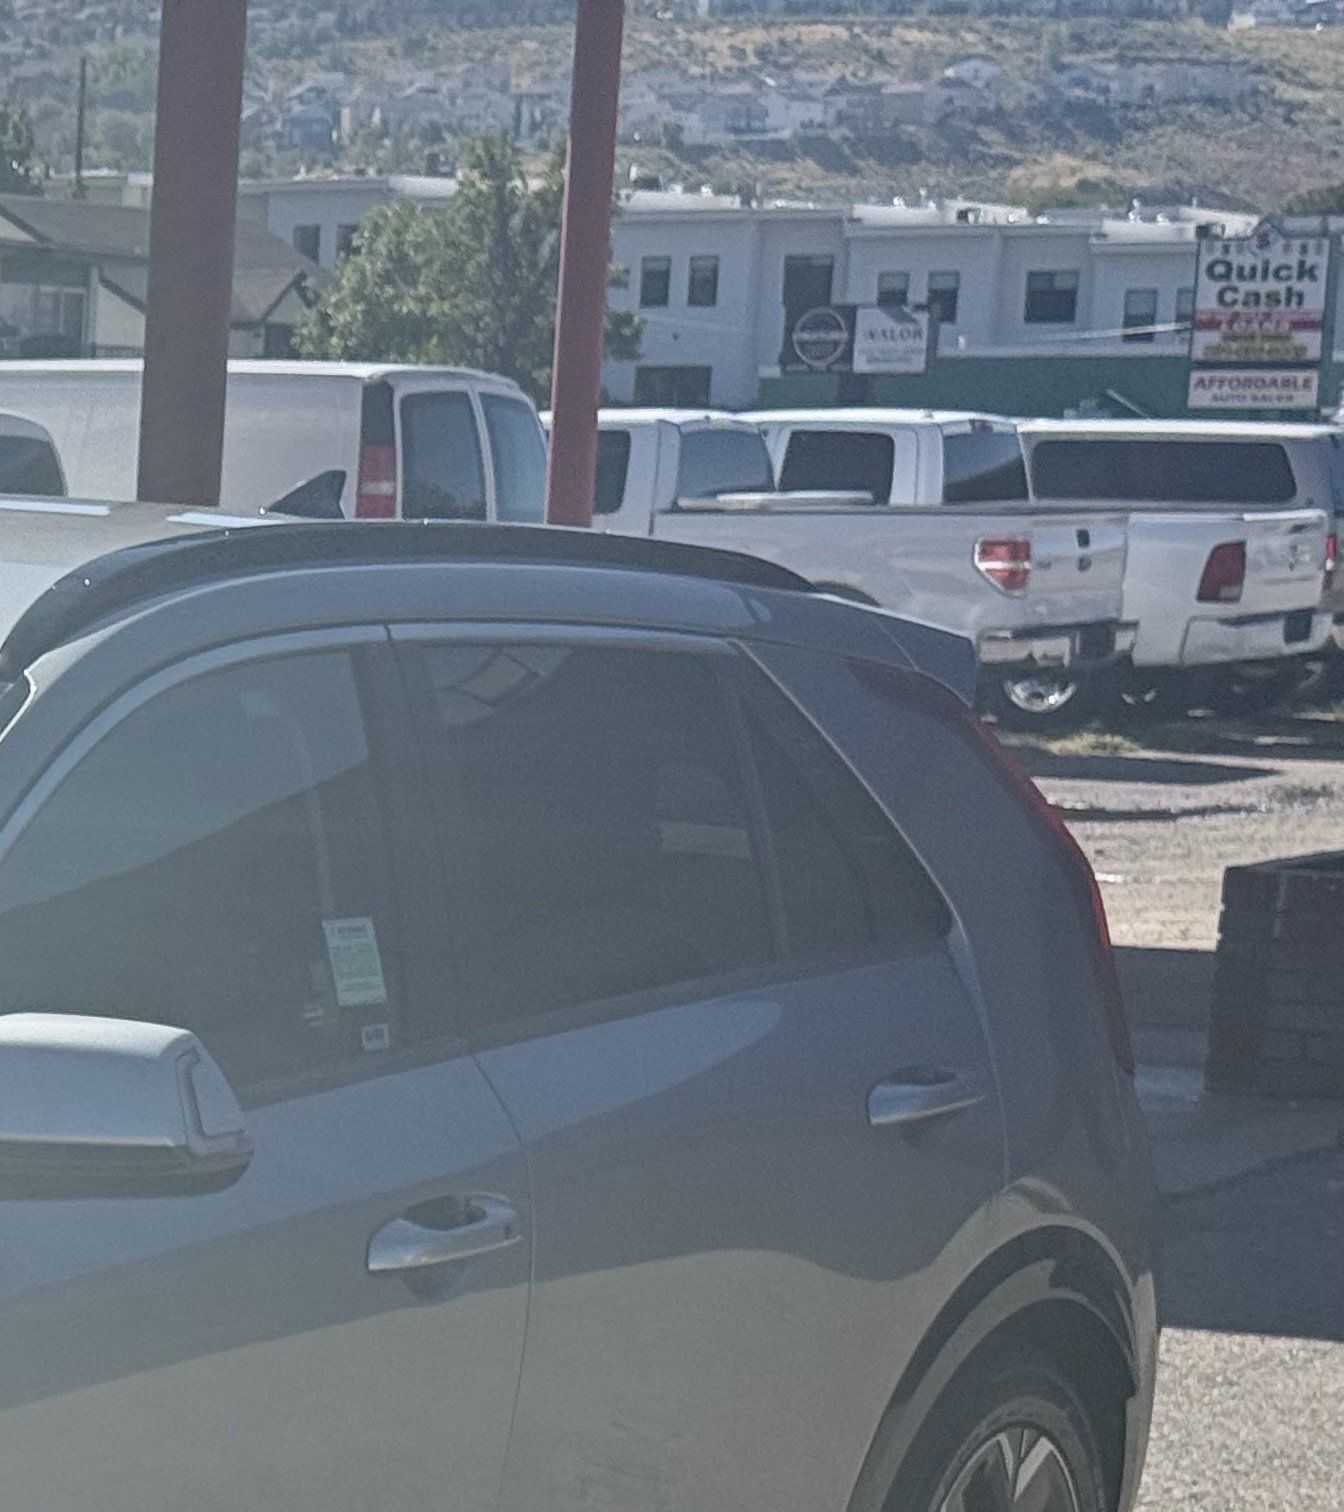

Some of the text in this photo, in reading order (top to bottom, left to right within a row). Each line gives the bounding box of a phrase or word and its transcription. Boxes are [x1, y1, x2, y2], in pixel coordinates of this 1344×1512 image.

[1205, 258, 1319, 282] Quick
[1216, 285, 1305, 307] Cash
[1193, 375, 1313, 391] AFFORDABLE
